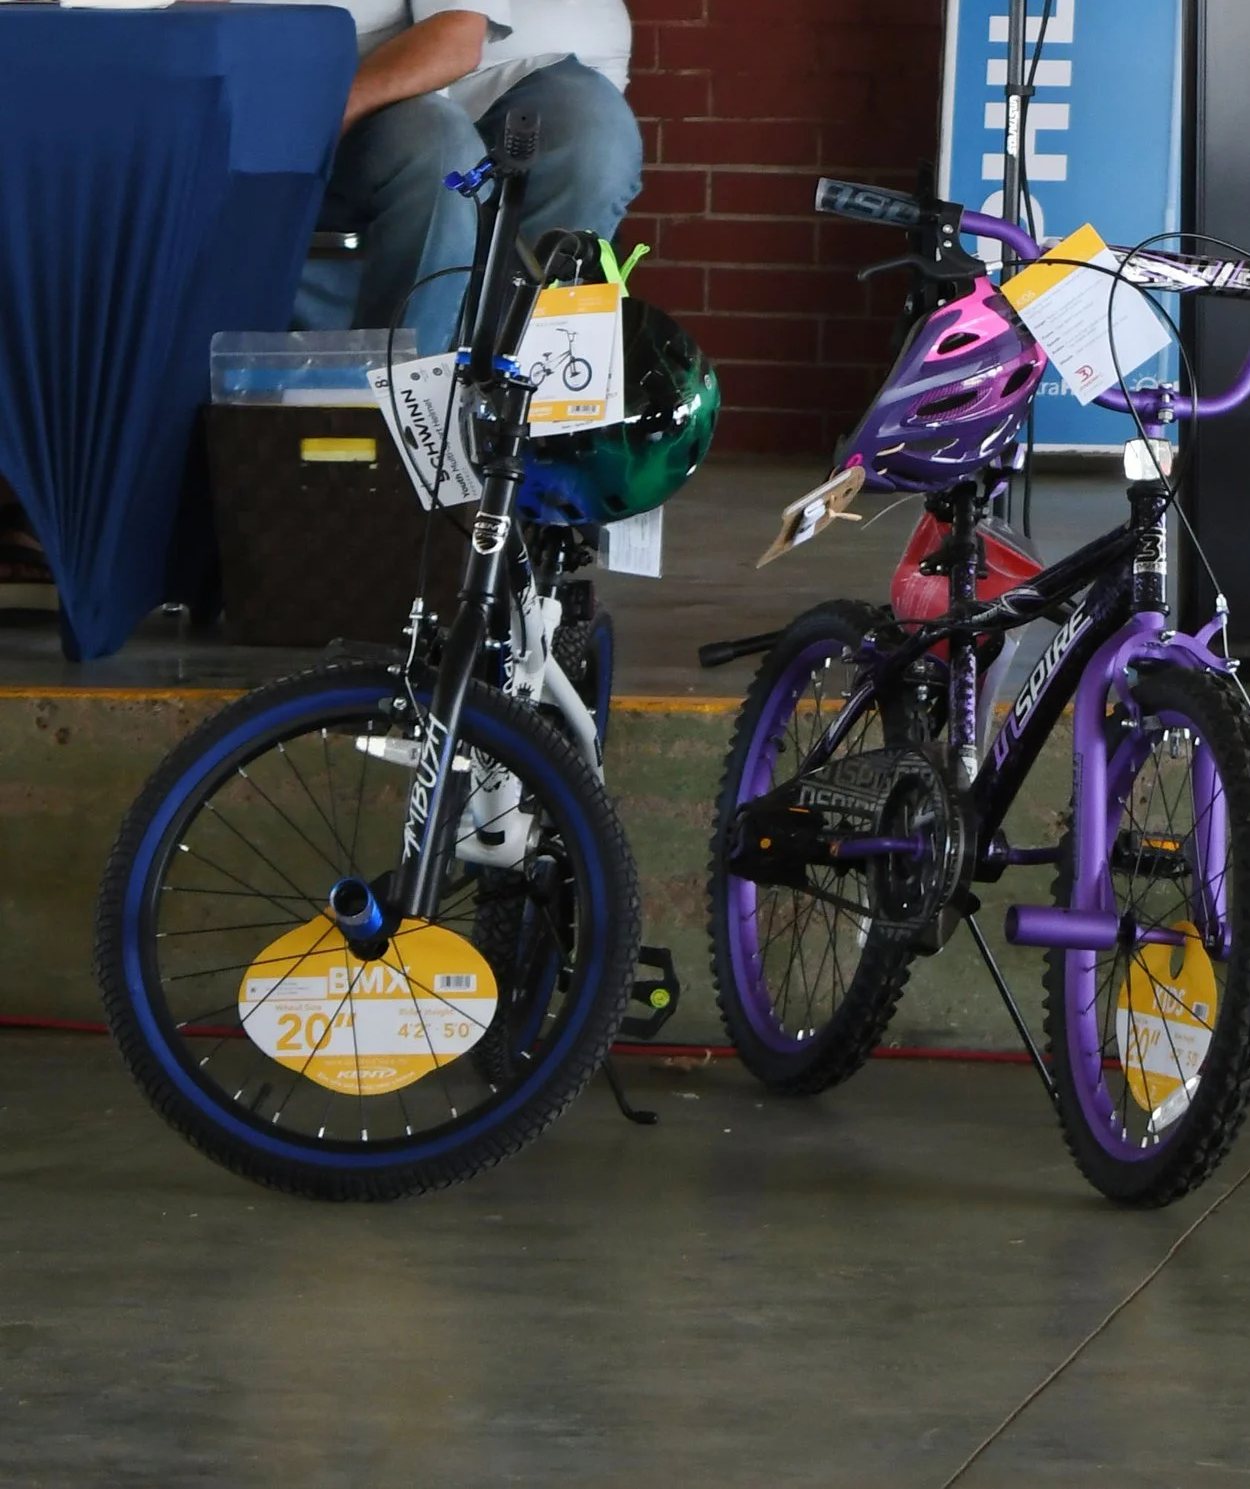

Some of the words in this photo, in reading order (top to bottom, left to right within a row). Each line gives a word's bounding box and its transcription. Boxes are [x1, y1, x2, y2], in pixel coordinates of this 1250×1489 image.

[423, 399, 440, 429] Helmet
[400, 389, 450, 484] SCHWINN
[455, 474, 471, 499] Youth
[402, 712, 451, 864] AMBUSH
[329, 965, 411, 995] BMX
[1152, 984, 1186, 1017] KIDS
[276, 1012, 357, 1051] 20"
[337, 1068, 392, 1080] KENT
